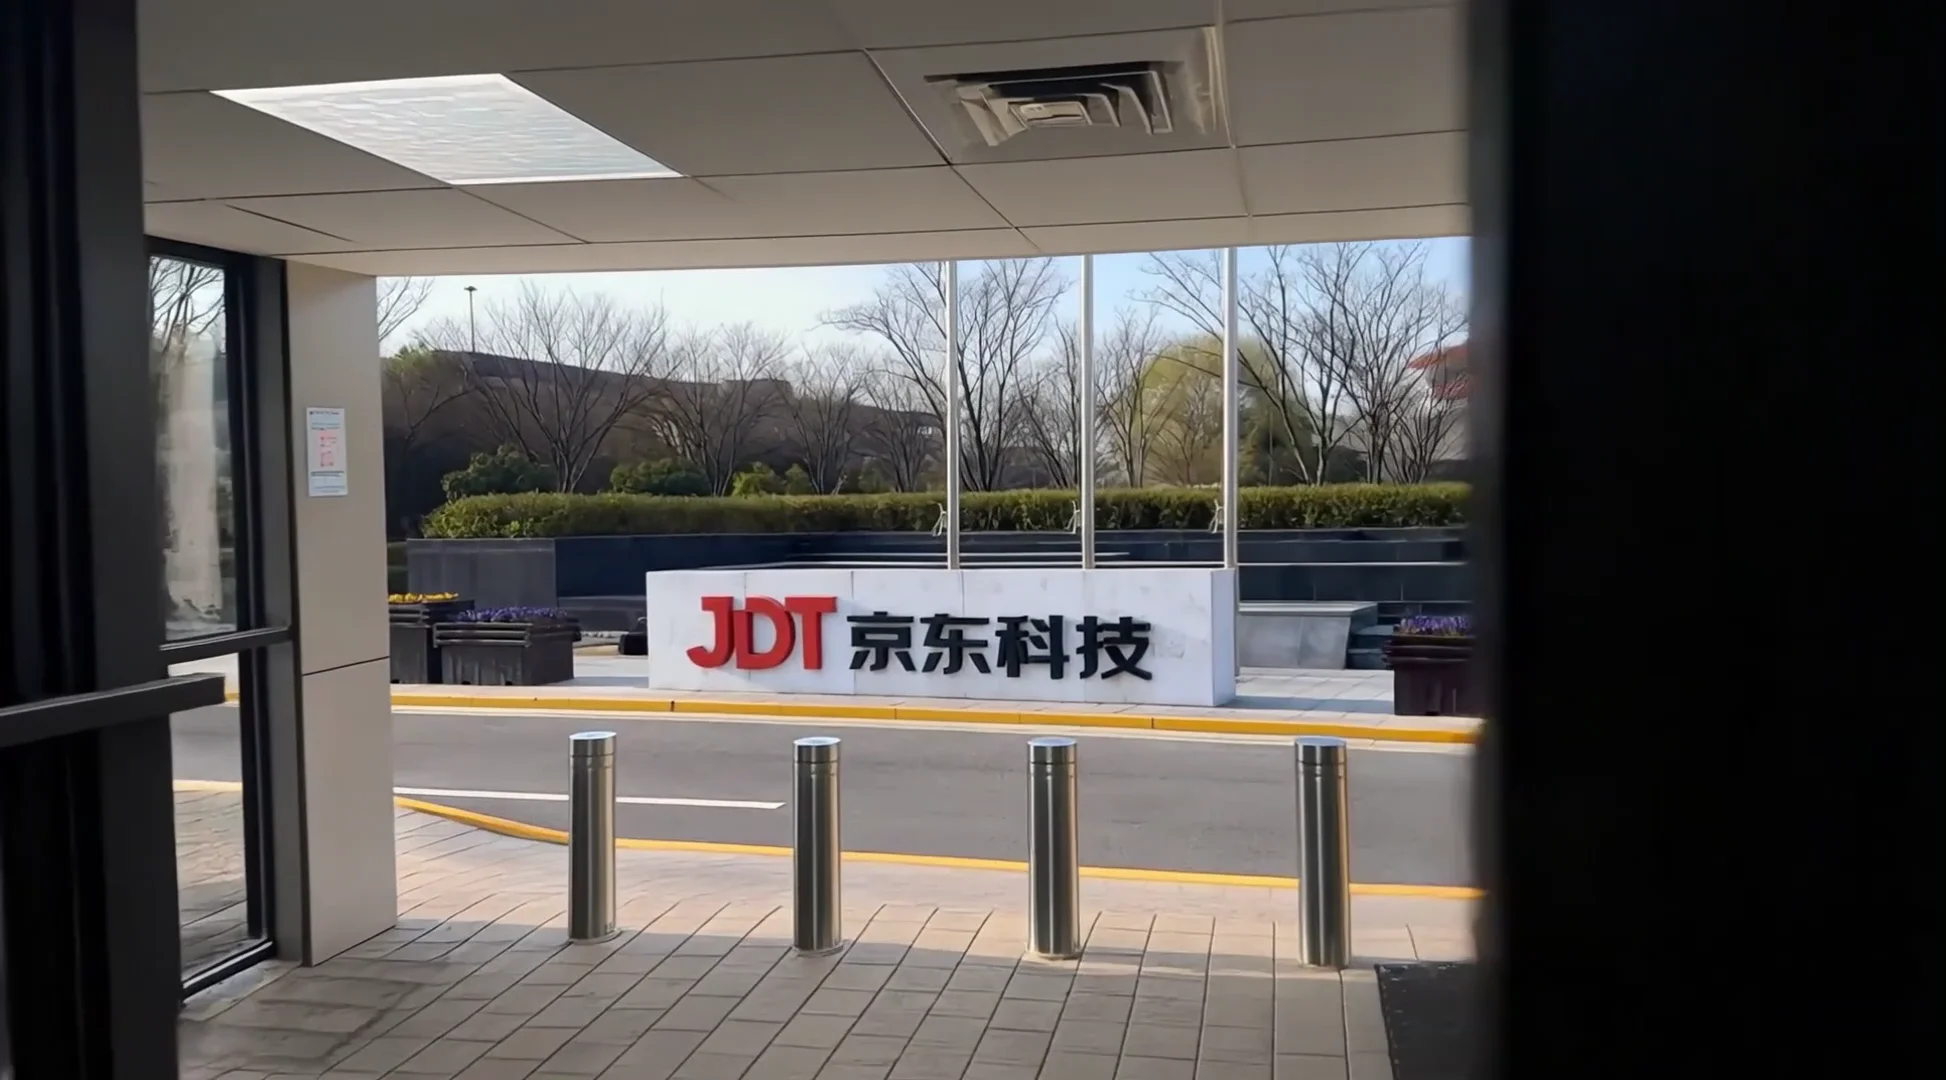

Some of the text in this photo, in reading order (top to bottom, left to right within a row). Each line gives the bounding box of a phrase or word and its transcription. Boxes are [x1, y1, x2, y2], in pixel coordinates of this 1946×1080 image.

[686, 596, 1153, 680] JDT 京东科技
